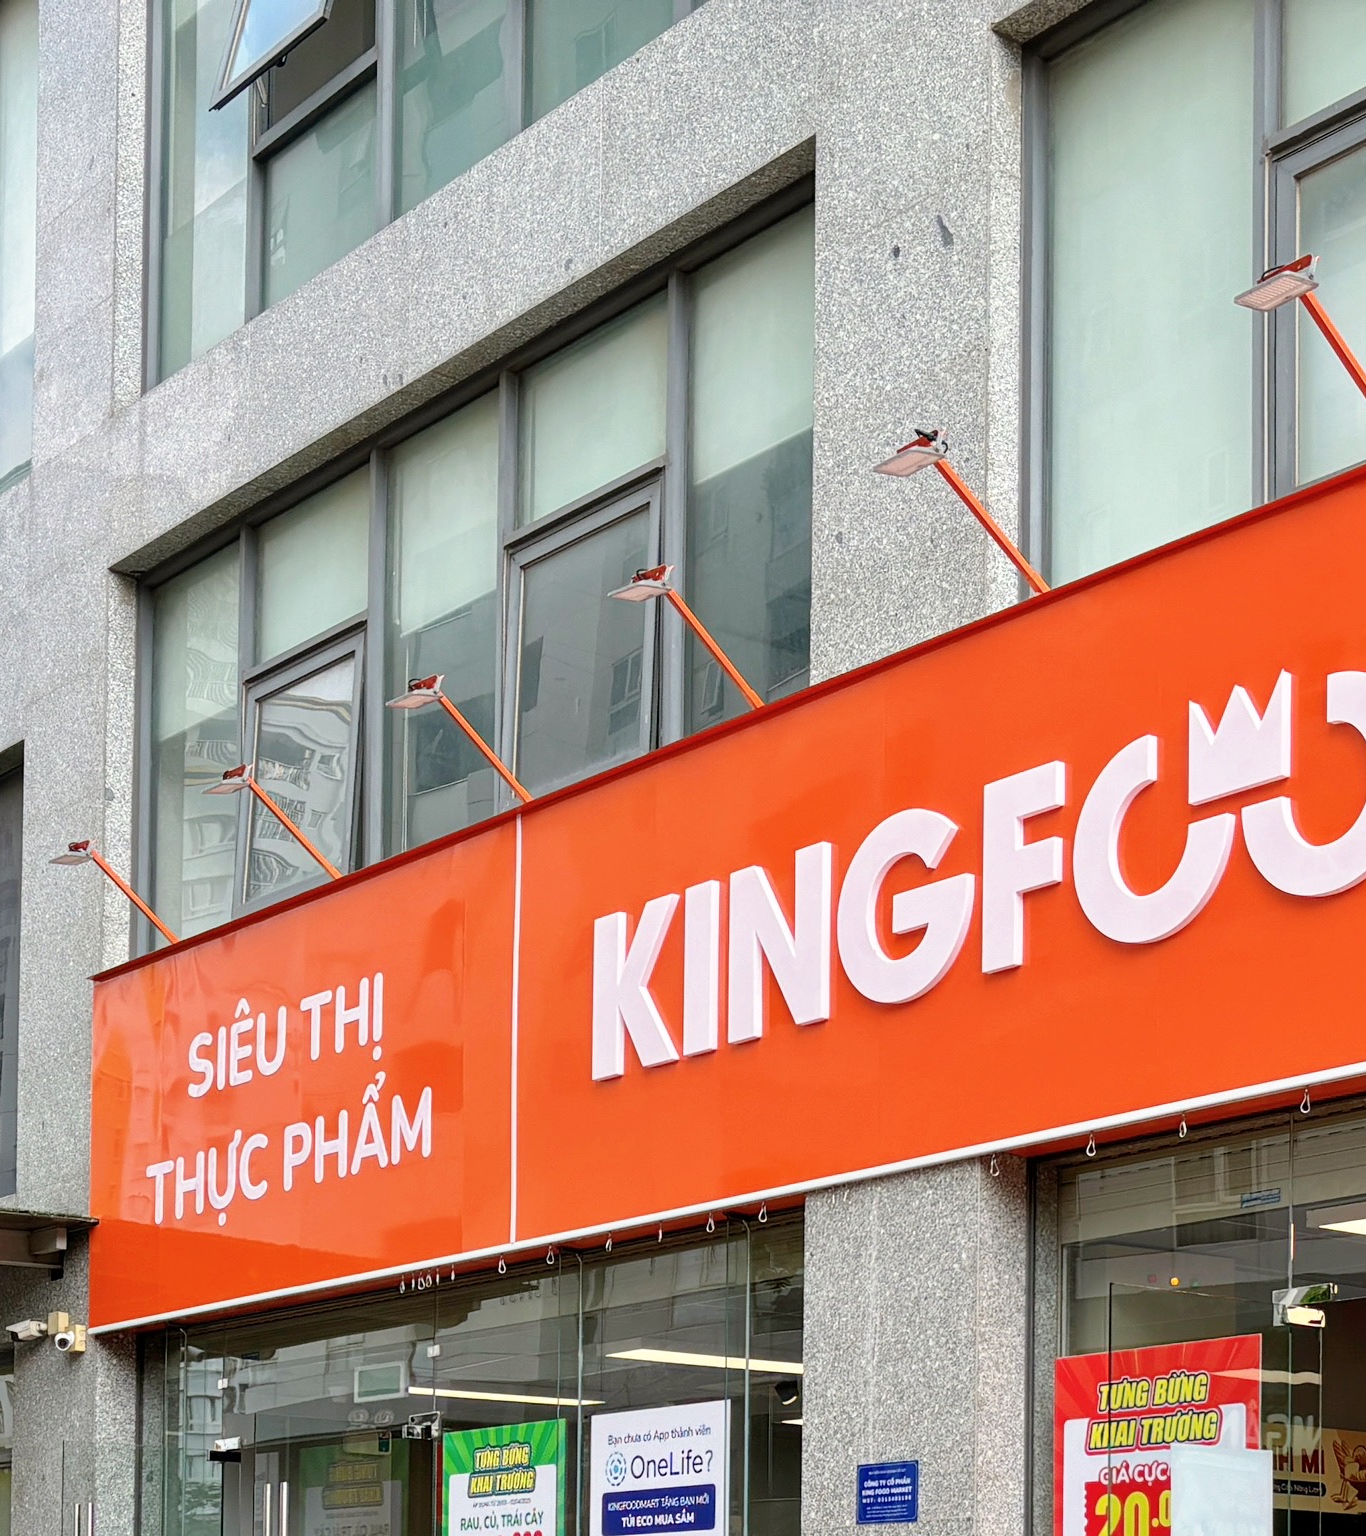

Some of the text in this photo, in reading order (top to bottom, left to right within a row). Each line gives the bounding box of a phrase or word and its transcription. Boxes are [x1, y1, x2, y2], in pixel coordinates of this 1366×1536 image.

[187, 971, 385, 1098] SIÊU THỊ
[145, 1070, 434, 1227] THỰC PHẨM
[1099, 1371, 1209, 1412] TƯNG BỪNG
[608, 1434, 623, 1446] Bạn
[653, 1430, 669, 1442] App
[1088, 1408, 1218, 1450] KHAI TRƯƠNG
[630, 1449, 714, 1479] OneLife?
[1099, 1460, 1168, 1486] GIÁ CỰC
[470, 1475, 493, 1494] KHAI
[501, 1512, 523, 1527] TRÁI
[636, 1517, 653, 1527] ECO
[654, 1515, 674, 1526] MUA
